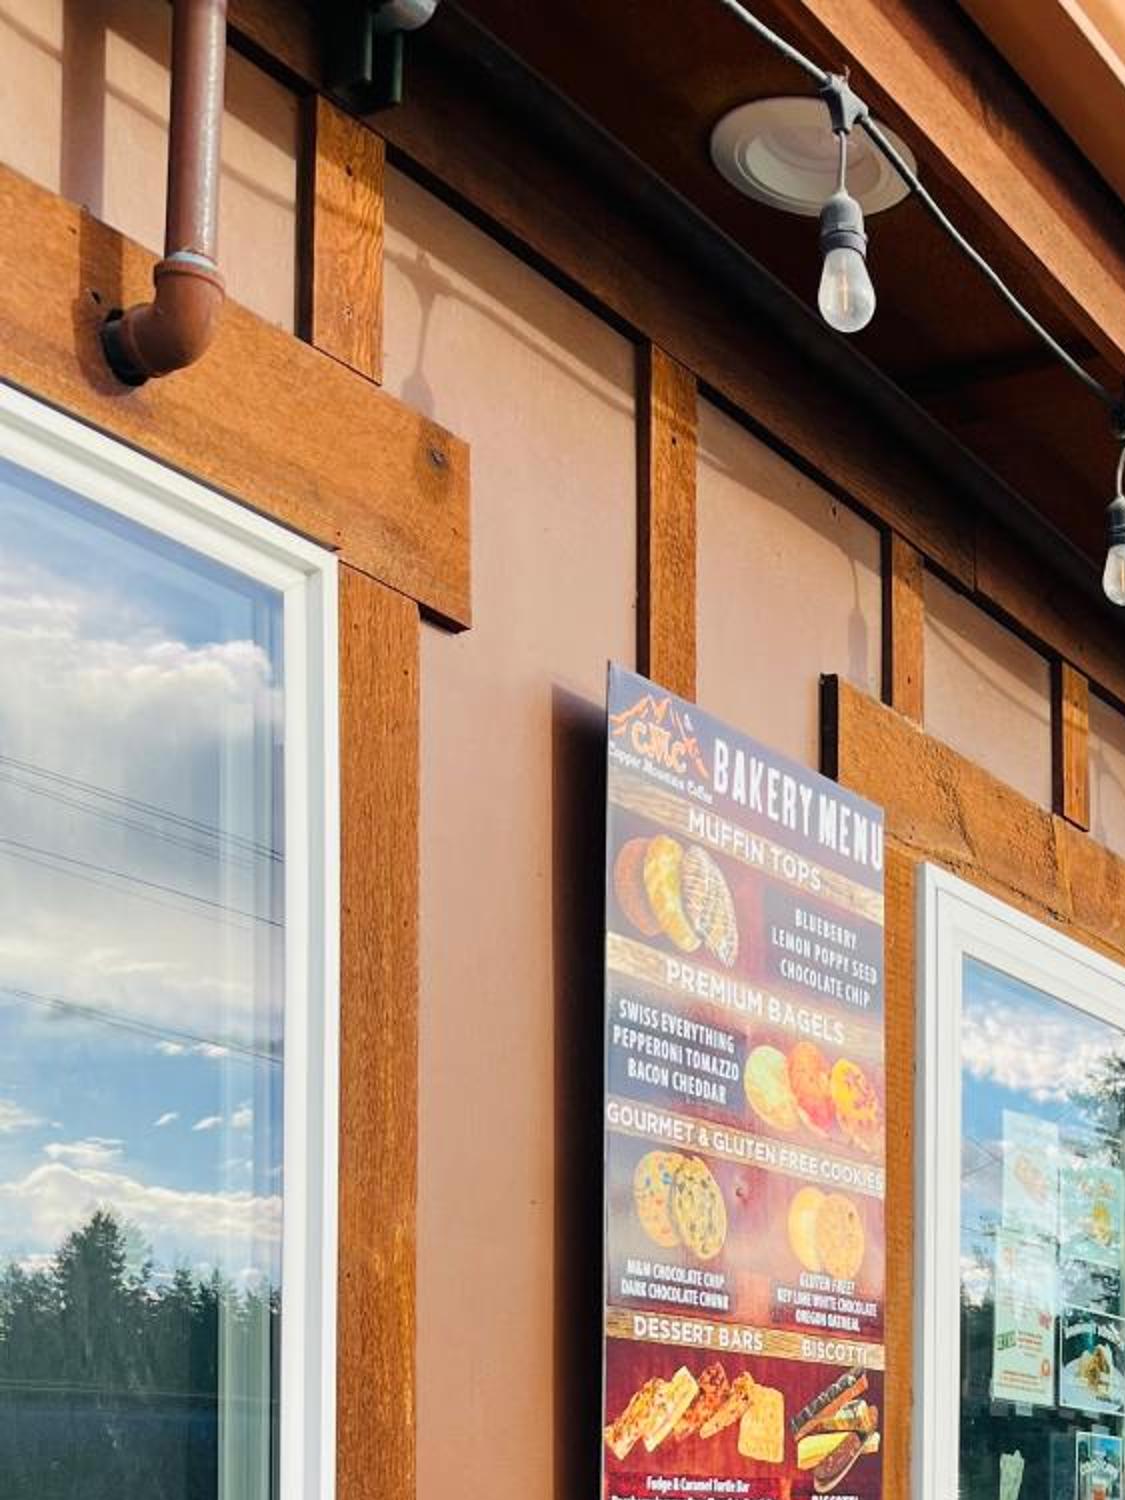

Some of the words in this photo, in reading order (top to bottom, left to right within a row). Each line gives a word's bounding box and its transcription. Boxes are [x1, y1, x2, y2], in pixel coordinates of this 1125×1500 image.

[713, 738, 812, 836] BAKERY
[819, 795, 883, 871] MENU
[688, 808, 765, 865] MUFFIN
[771, 849, 821, 890] TOPS
[795, 908, 857, 950] BLUEBERRY
[771, 926, 811, 958] LEMON
[815, 943, 849, 972] POPPY
[852, 959, 877, 985] SEED
[666, 959, 763, 1017] PREMIUM
[767, 997, 845, 1045] BAGELS
[780, 958, 843, 999] CHOCOLATE
[845, 983, 871, 1008] CHIP
[613, 1024, 683, 1065] PEPPERONI
[685, 1047, 739, 1081] TOMAZZO
[619, 999, 659, 1029] SWISS
[661, 1011, 735, 1054] EVERYTHING
[627, 1058, 669, 1088] BACON
[671, 1071, 727, 1104] CHEDDAR
[607, 1102, 694, 1143] GOURMET
[698, 1127, 709, 1147] &
[713, 1131, 777, 1164] GLUTEN
[779, 1148, 818, 1175] FREE
[820, 1160, 883, 1191] COOKIES
[648, 1282, 699, 1305] CHOCOLATE
[653, 1263, 702, 1286] CHOCOLATE
[634, 1315, 714, 1346] DESSERT
[719, 1326, 763, 1351] BARS
[801, 1339, 867, 1364] BISCOTTI
